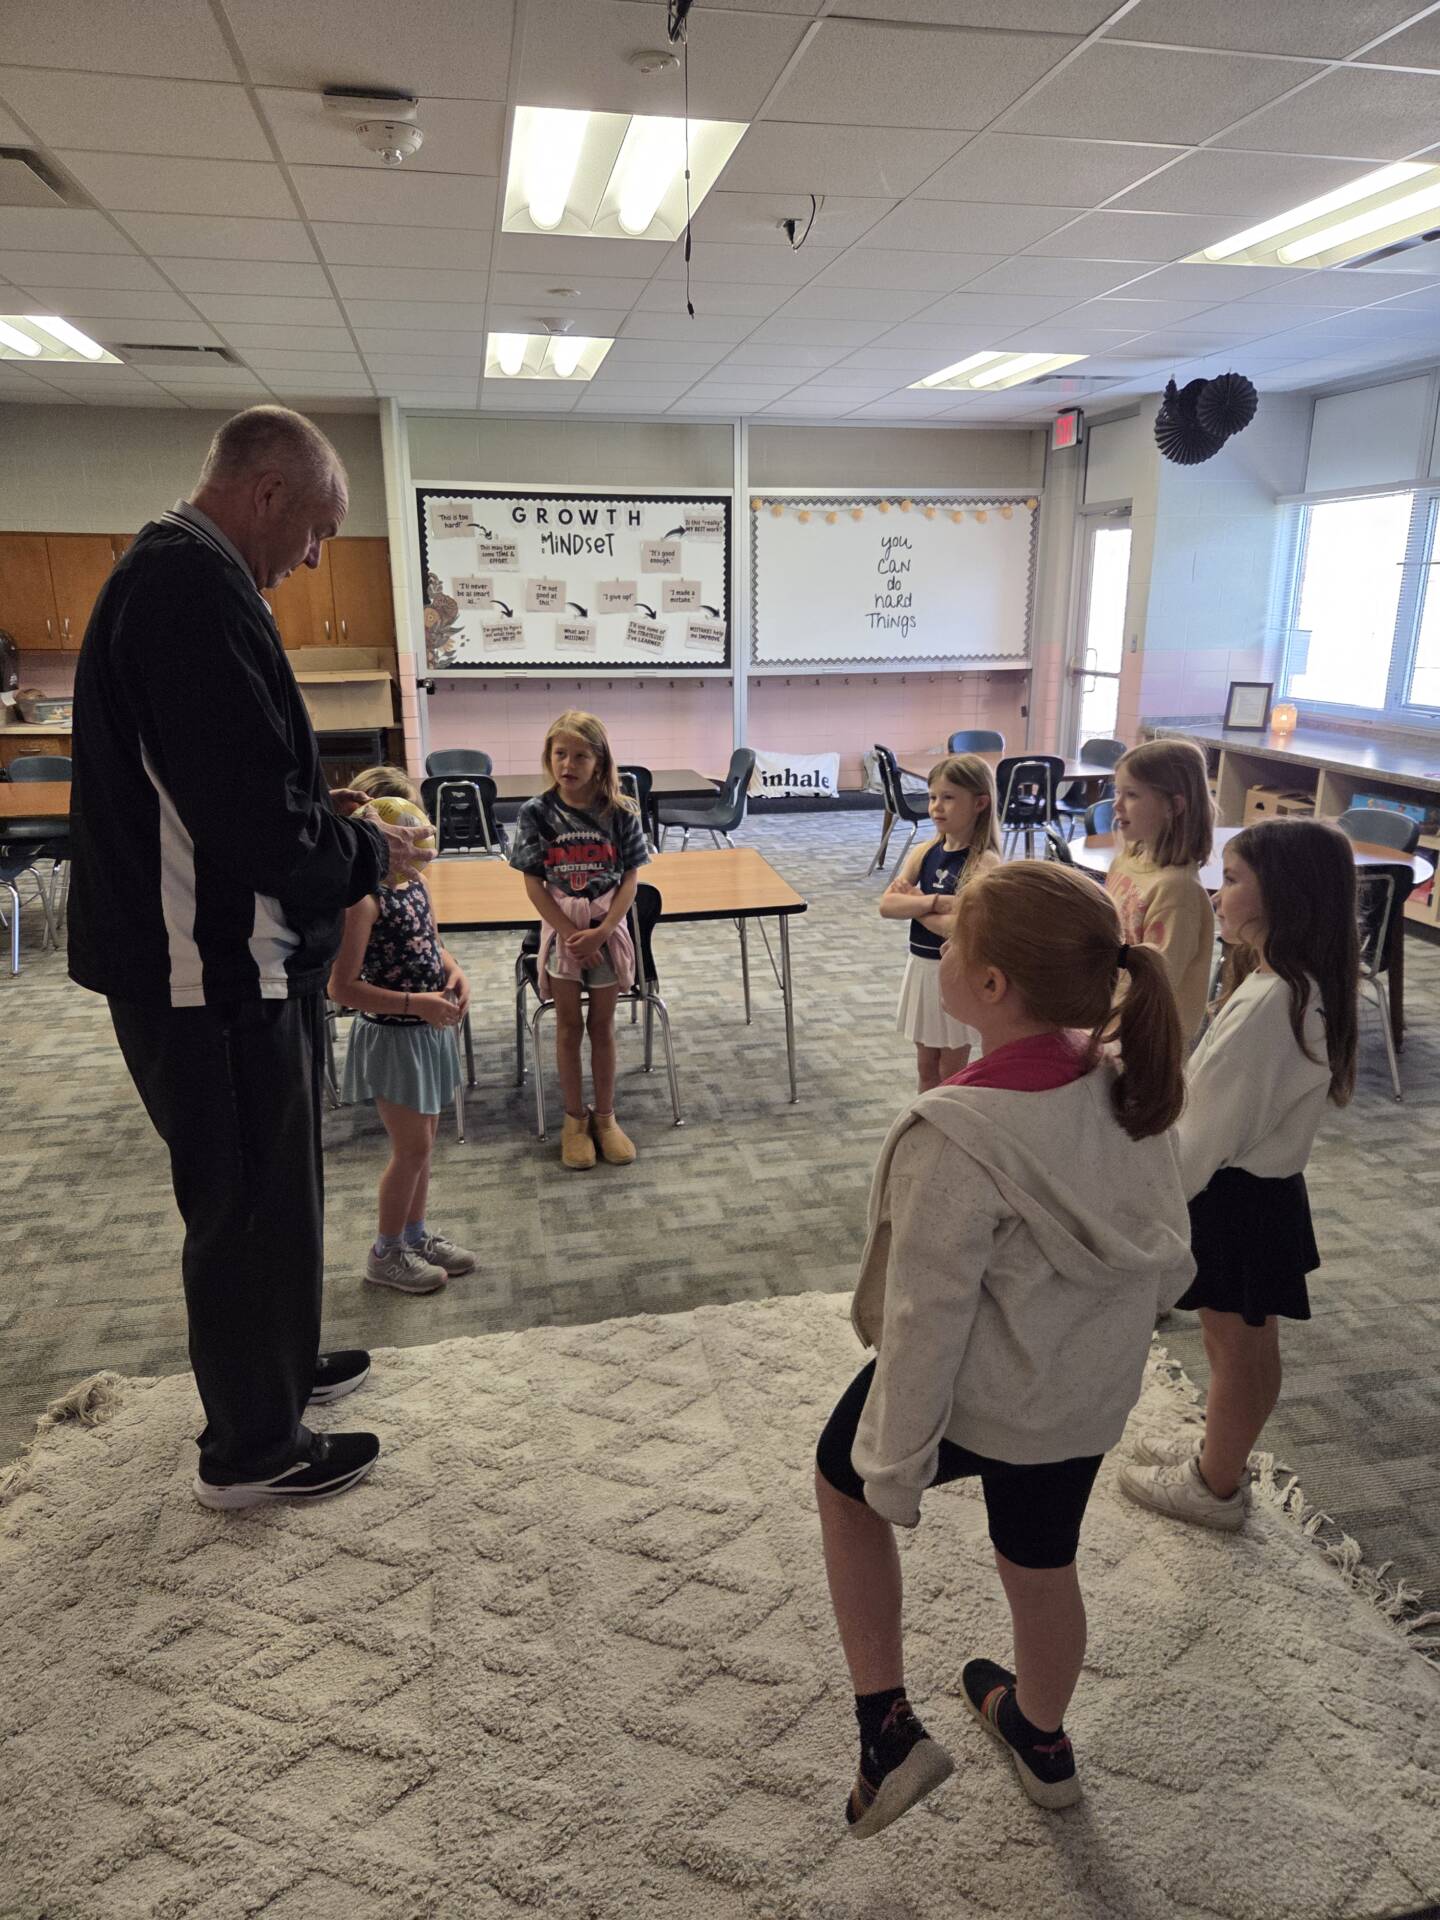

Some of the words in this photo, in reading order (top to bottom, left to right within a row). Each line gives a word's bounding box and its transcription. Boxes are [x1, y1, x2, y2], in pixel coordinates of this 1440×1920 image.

[512, 507, 640, 526] GROWTH
[881, 536, 912, 560] you
[887, 576, 901, 591] do
[610, 593, 621, 601] give
[761, 768, 830, 788] inhale
[553, 863, 604, 872] FOOTBALL
